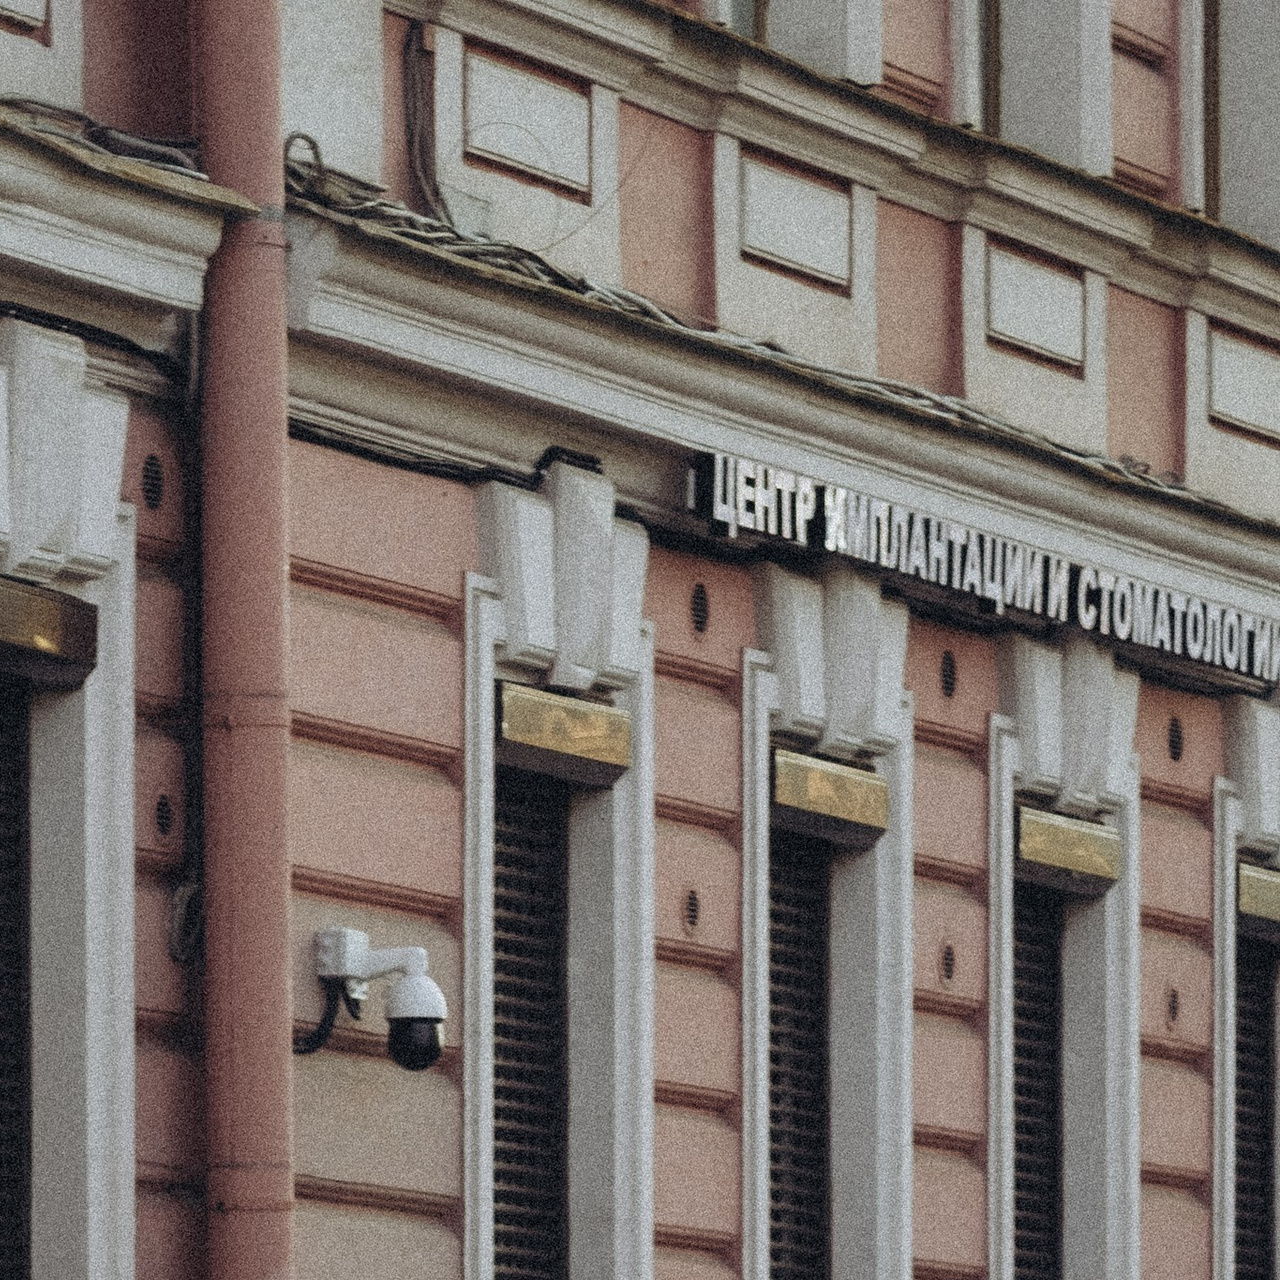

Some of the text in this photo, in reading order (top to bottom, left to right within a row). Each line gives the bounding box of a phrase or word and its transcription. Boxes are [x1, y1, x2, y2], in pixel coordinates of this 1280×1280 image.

[713, 453, 817, 547] ЦЕНТР
[824, 484, 1043, 615] ИМПЛАНТАЦИИ
[1048, 551, 1070, 622] И
